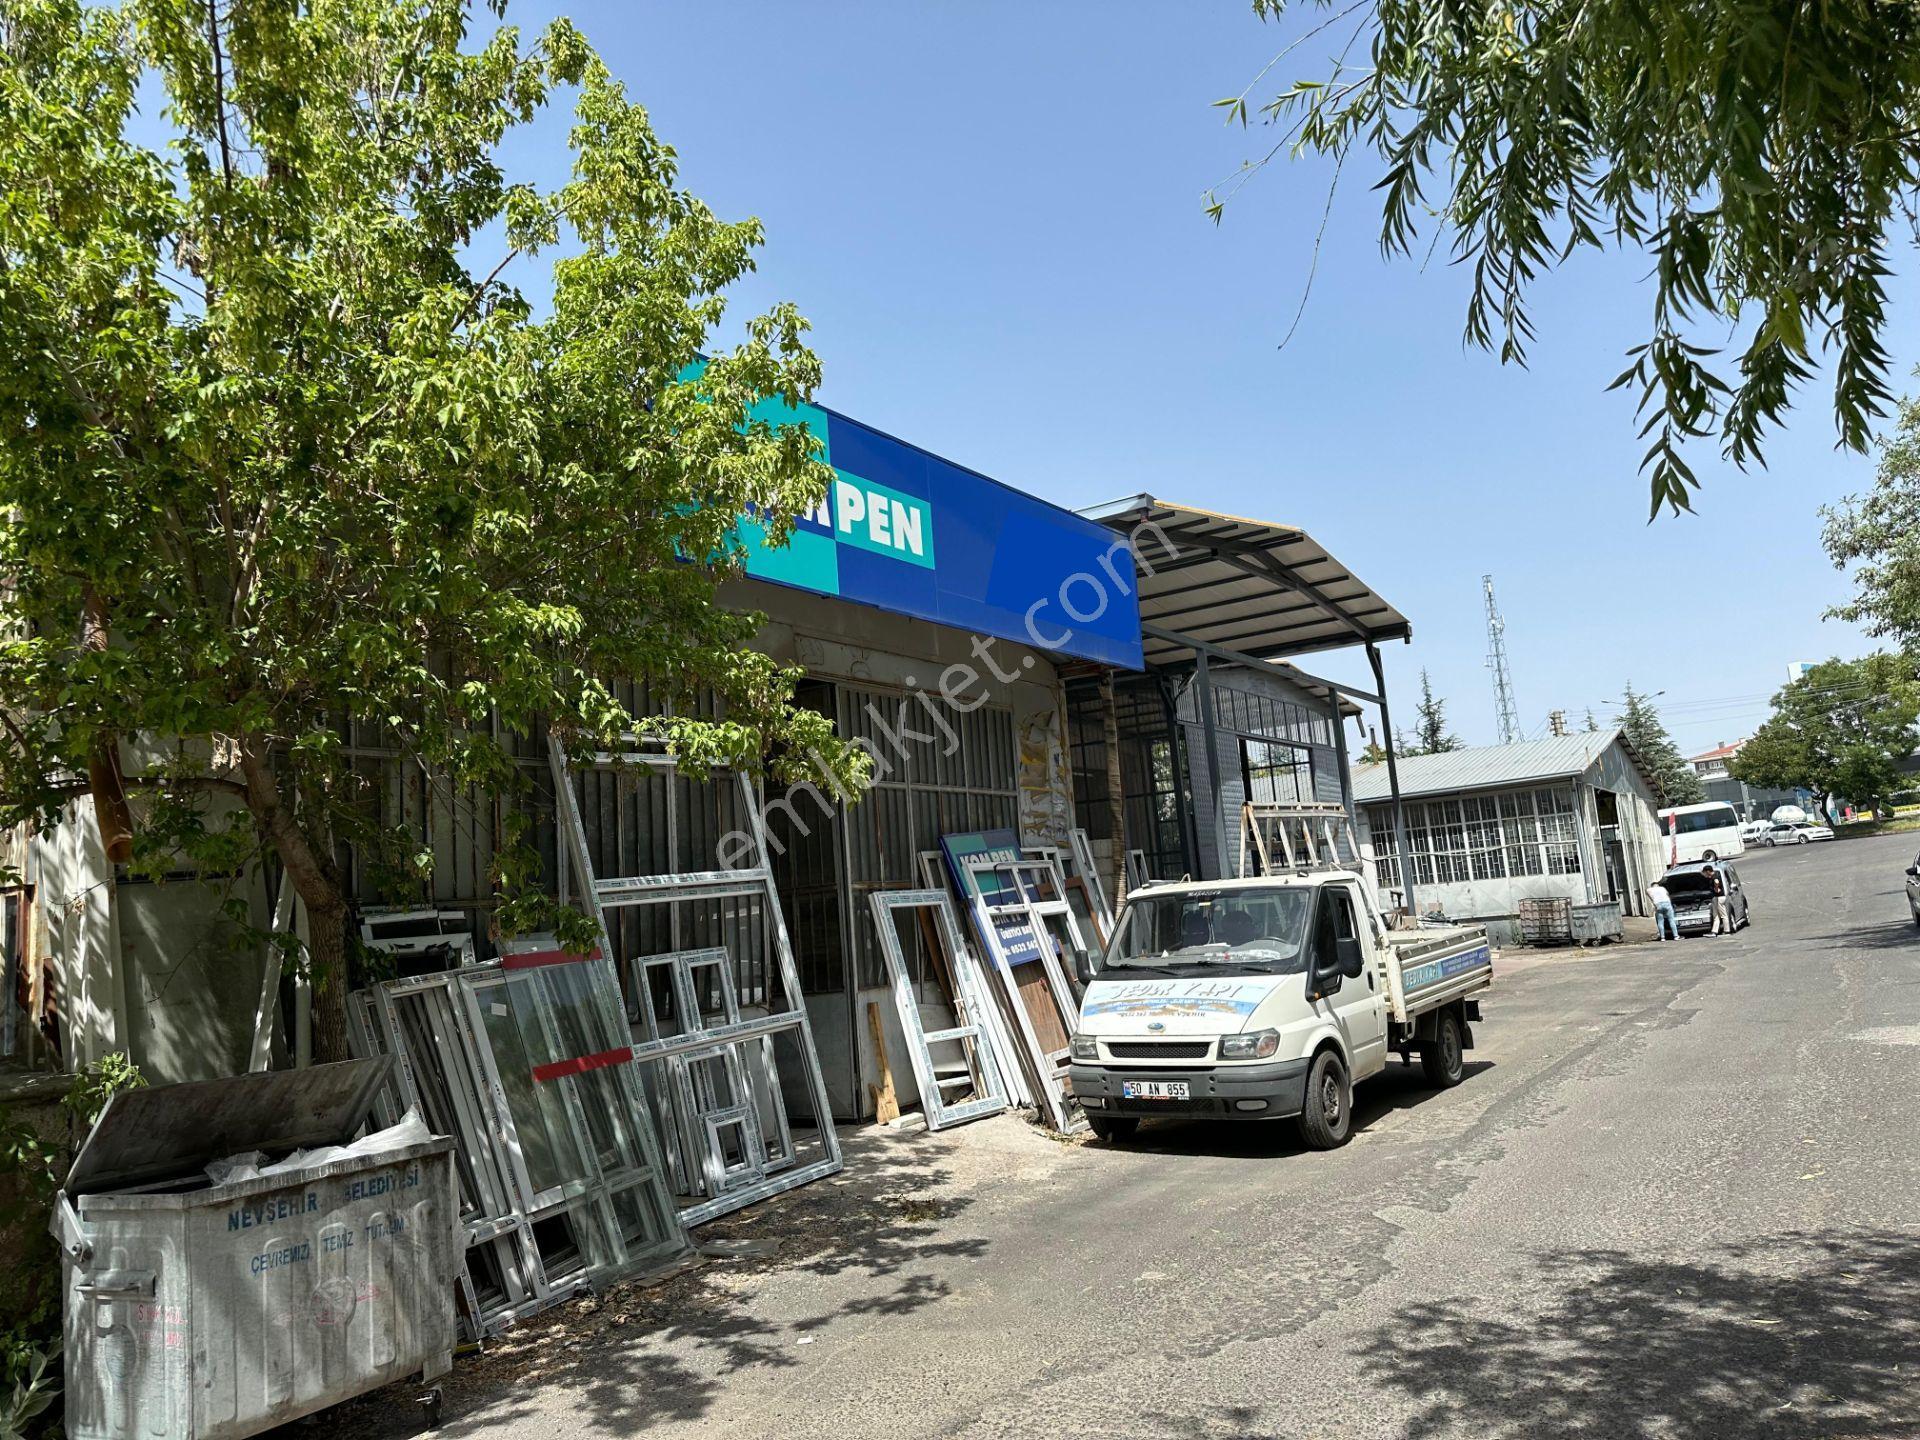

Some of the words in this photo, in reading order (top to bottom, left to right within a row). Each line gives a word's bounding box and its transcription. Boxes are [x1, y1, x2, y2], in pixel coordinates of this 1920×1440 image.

[1130, 1082, 1142, 1095] 50
[1148, 1083, 1160, 1095] AN
[1167, 1084, 1186, 1096] 855
[228, 1192, 318, 1231] NEVŞEHİR
